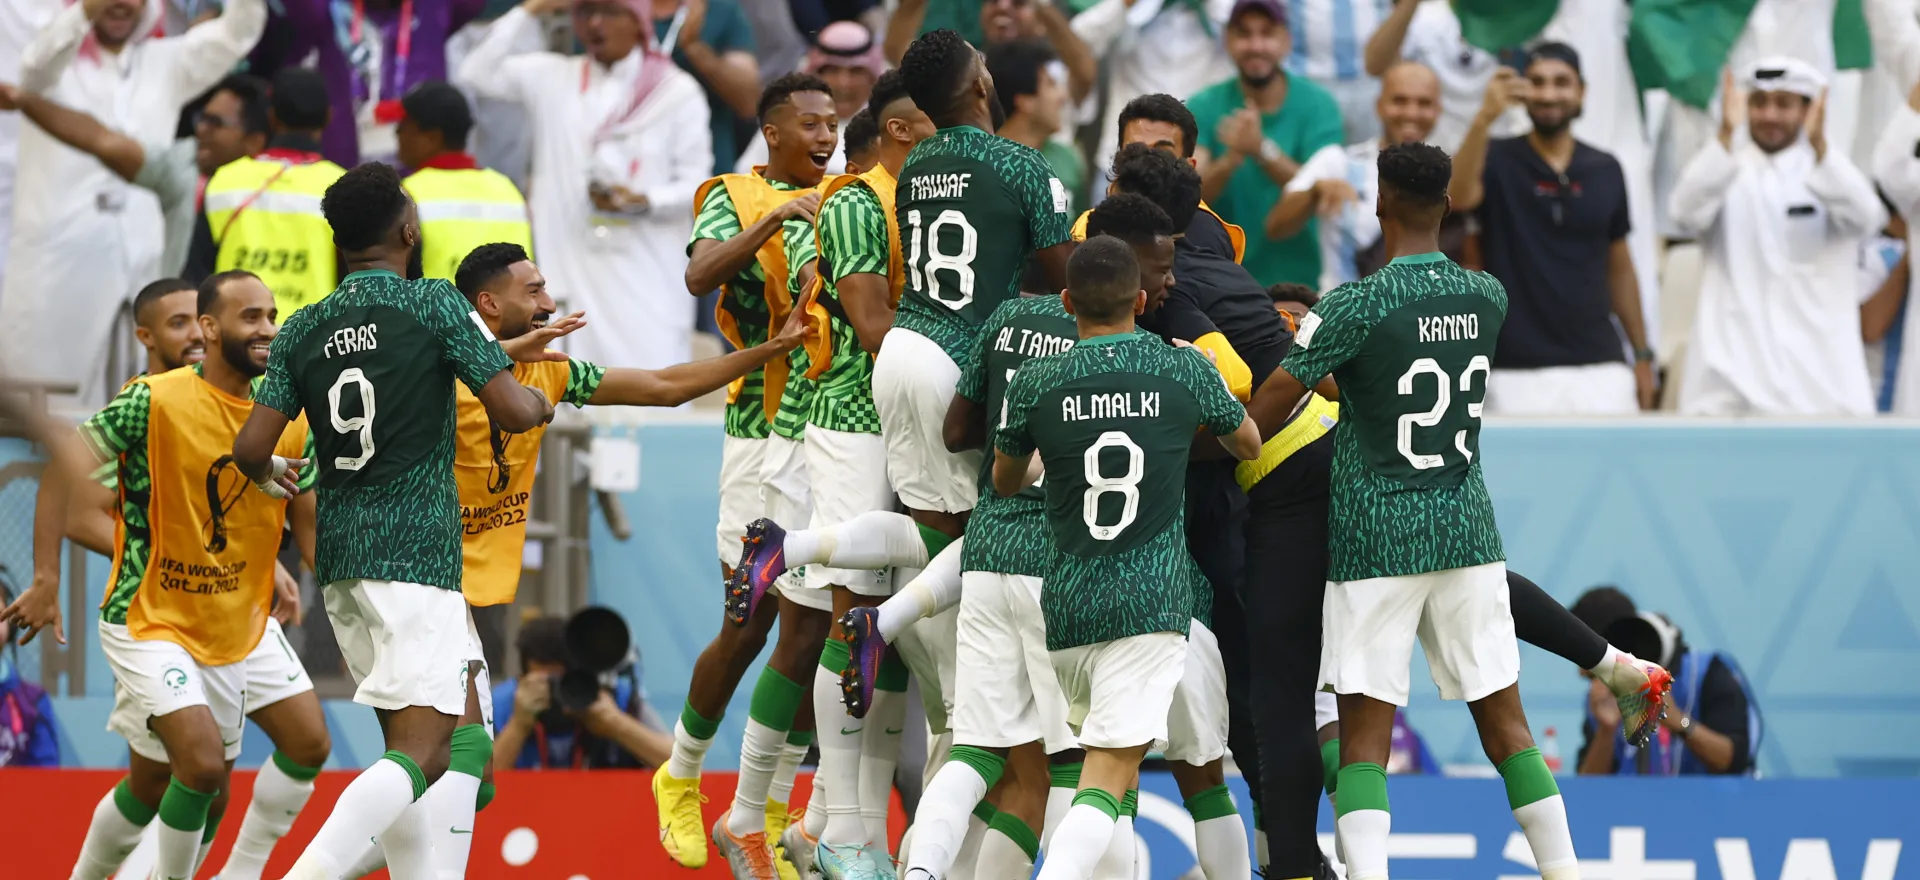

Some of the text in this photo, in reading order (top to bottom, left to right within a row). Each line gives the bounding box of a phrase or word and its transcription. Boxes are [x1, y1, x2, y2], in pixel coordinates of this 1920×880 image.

[911, 173, 972, 200] NAWAF
[908, 209, 977, 311] 18
[324, 323, 377, 359] FERAS
[994, 326, 1014, 352] AL
[1418, 313, 1478, 342] KANNO
[327, 367, 376, 471] 9
[1062, 391, 1160, 422] ALMALKI
[1397, 355, 1491, 470] 23
[503, 491, 529, 508] CUP
[1083, 431, 1145, 541] 8
[188, 564, 230, 578] WORLD
